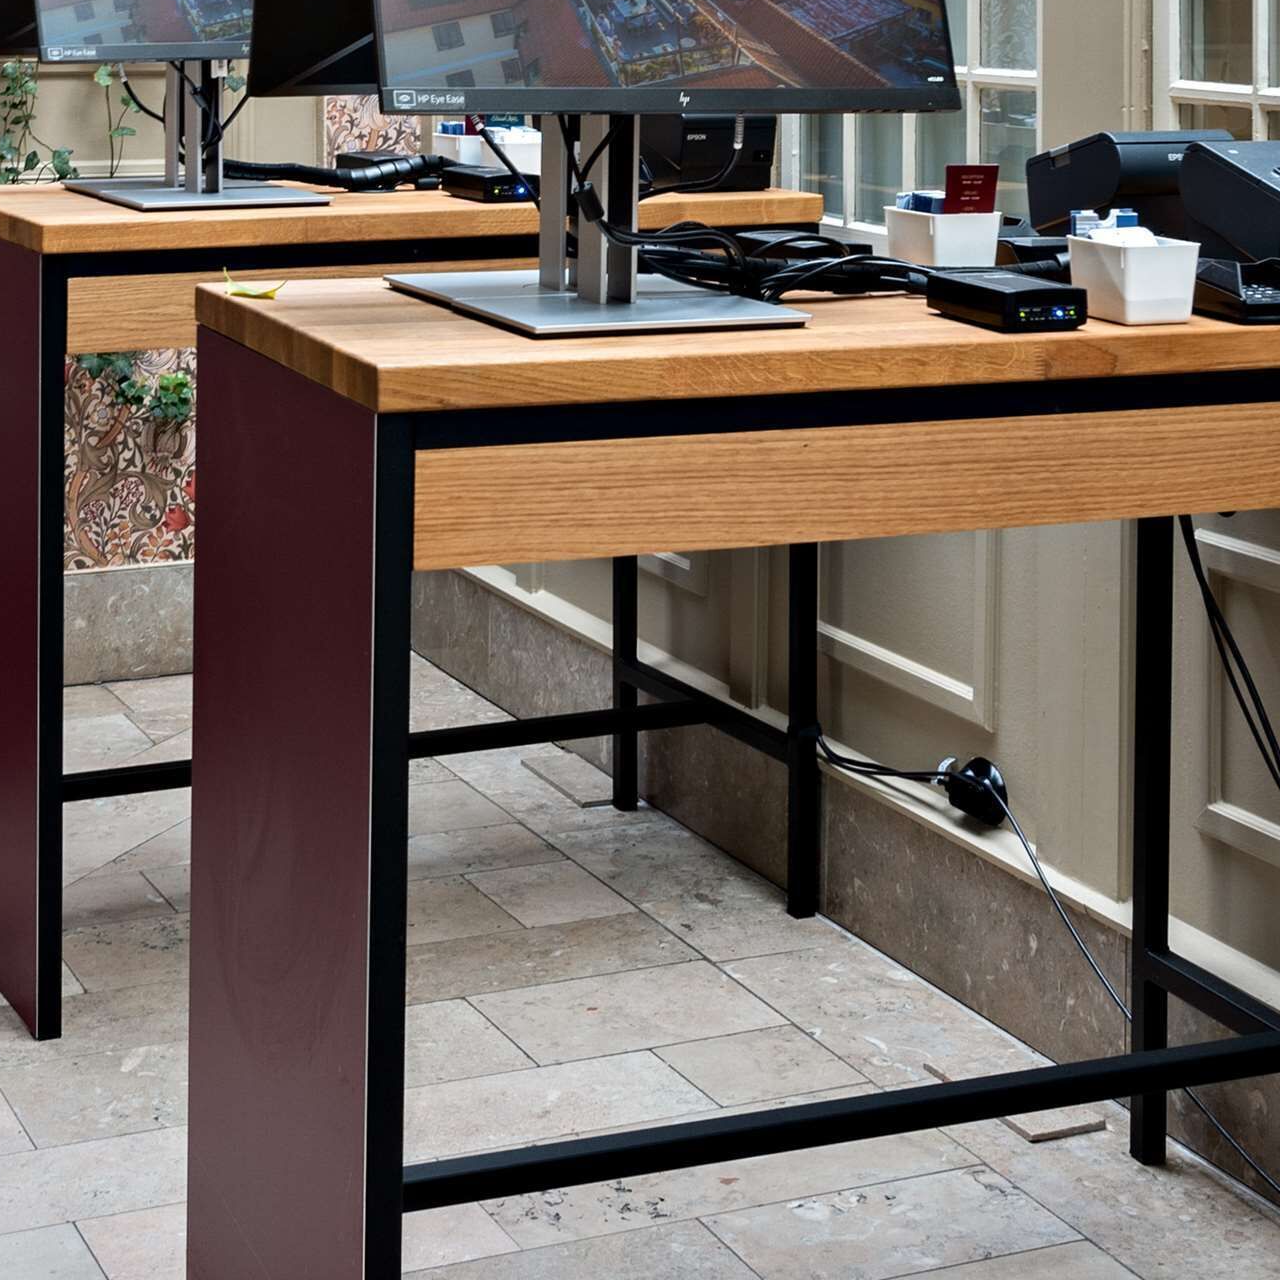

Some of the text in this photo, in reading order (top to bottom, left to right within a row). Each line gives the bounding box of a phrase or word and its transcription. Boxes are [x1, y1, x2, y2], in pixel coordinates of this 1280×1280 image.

[417, 94, 465, 105] HP Eye Ease
